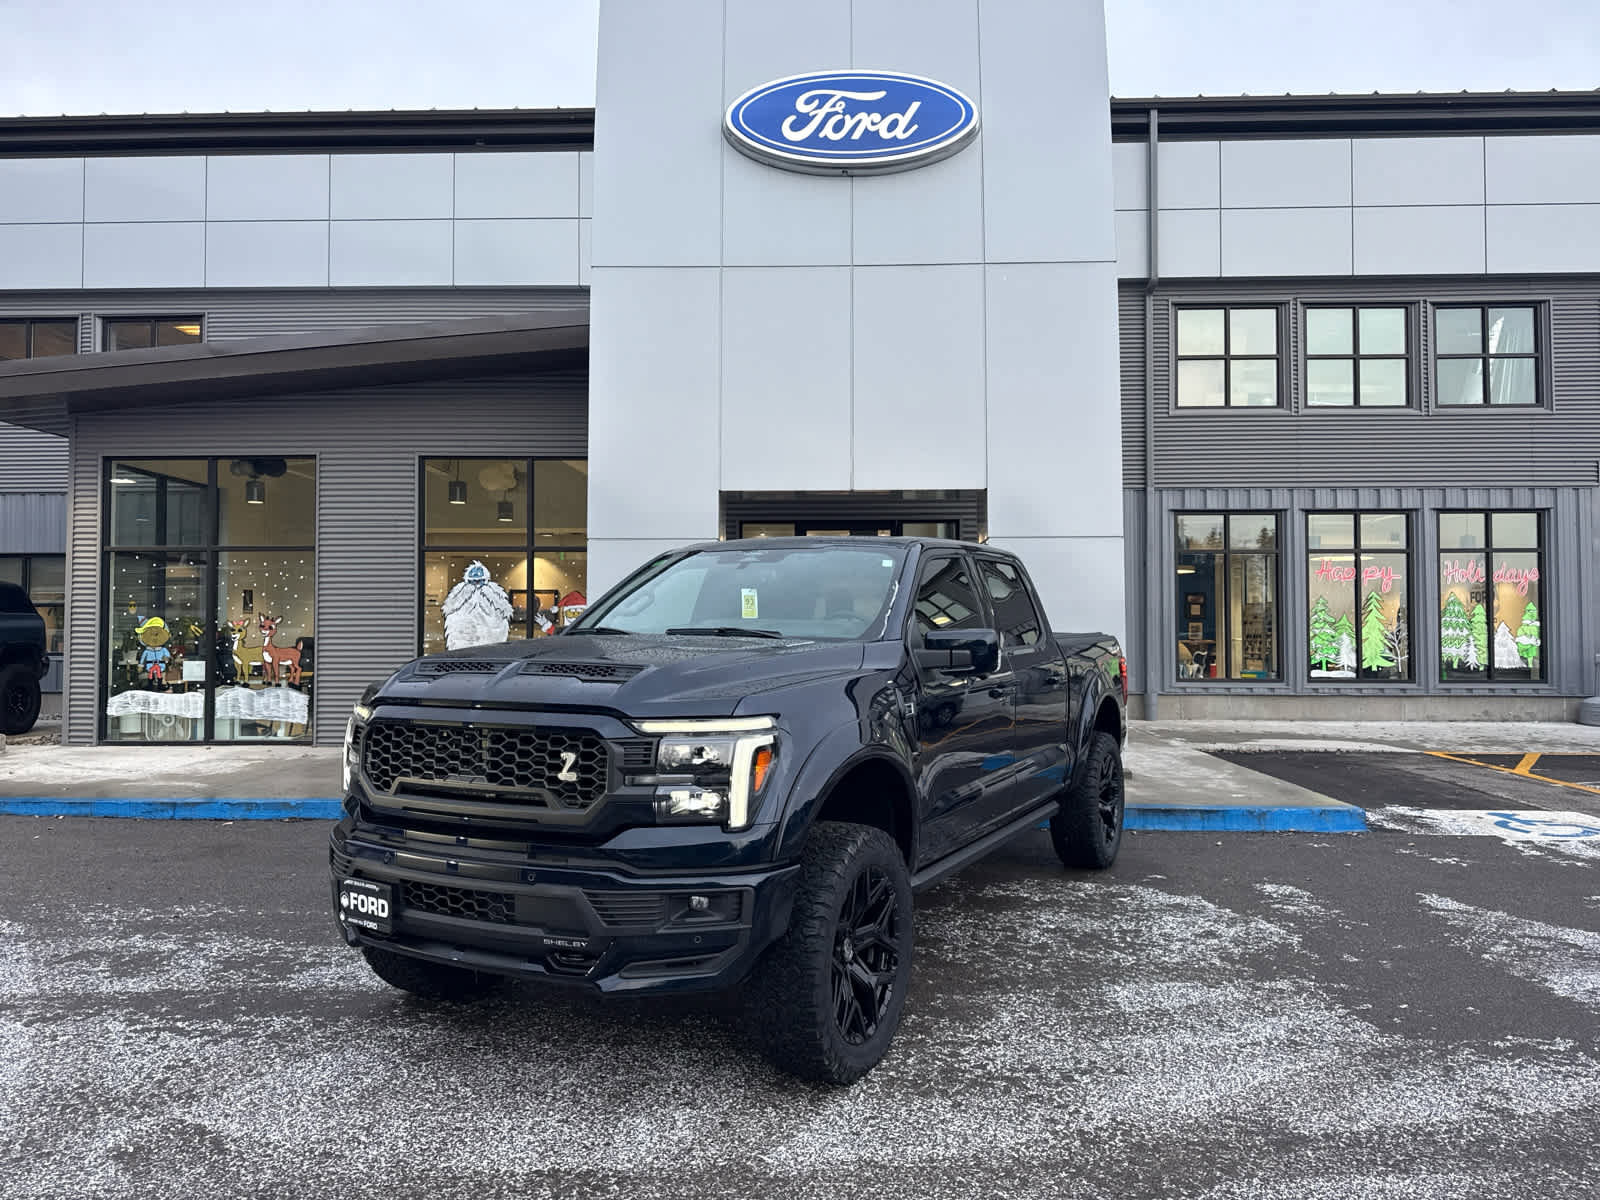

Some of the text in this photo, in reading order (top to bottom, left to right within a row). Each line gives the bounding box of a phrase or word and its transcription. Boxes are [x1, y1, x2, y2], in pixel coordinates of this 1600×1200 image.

[781, 88, 922, 142] Ford
[1314, 557, 1539, 597] Happy Holidays
[349, 891, 389, 919] FORD
[543, 938, 588, 948] SHELBY
